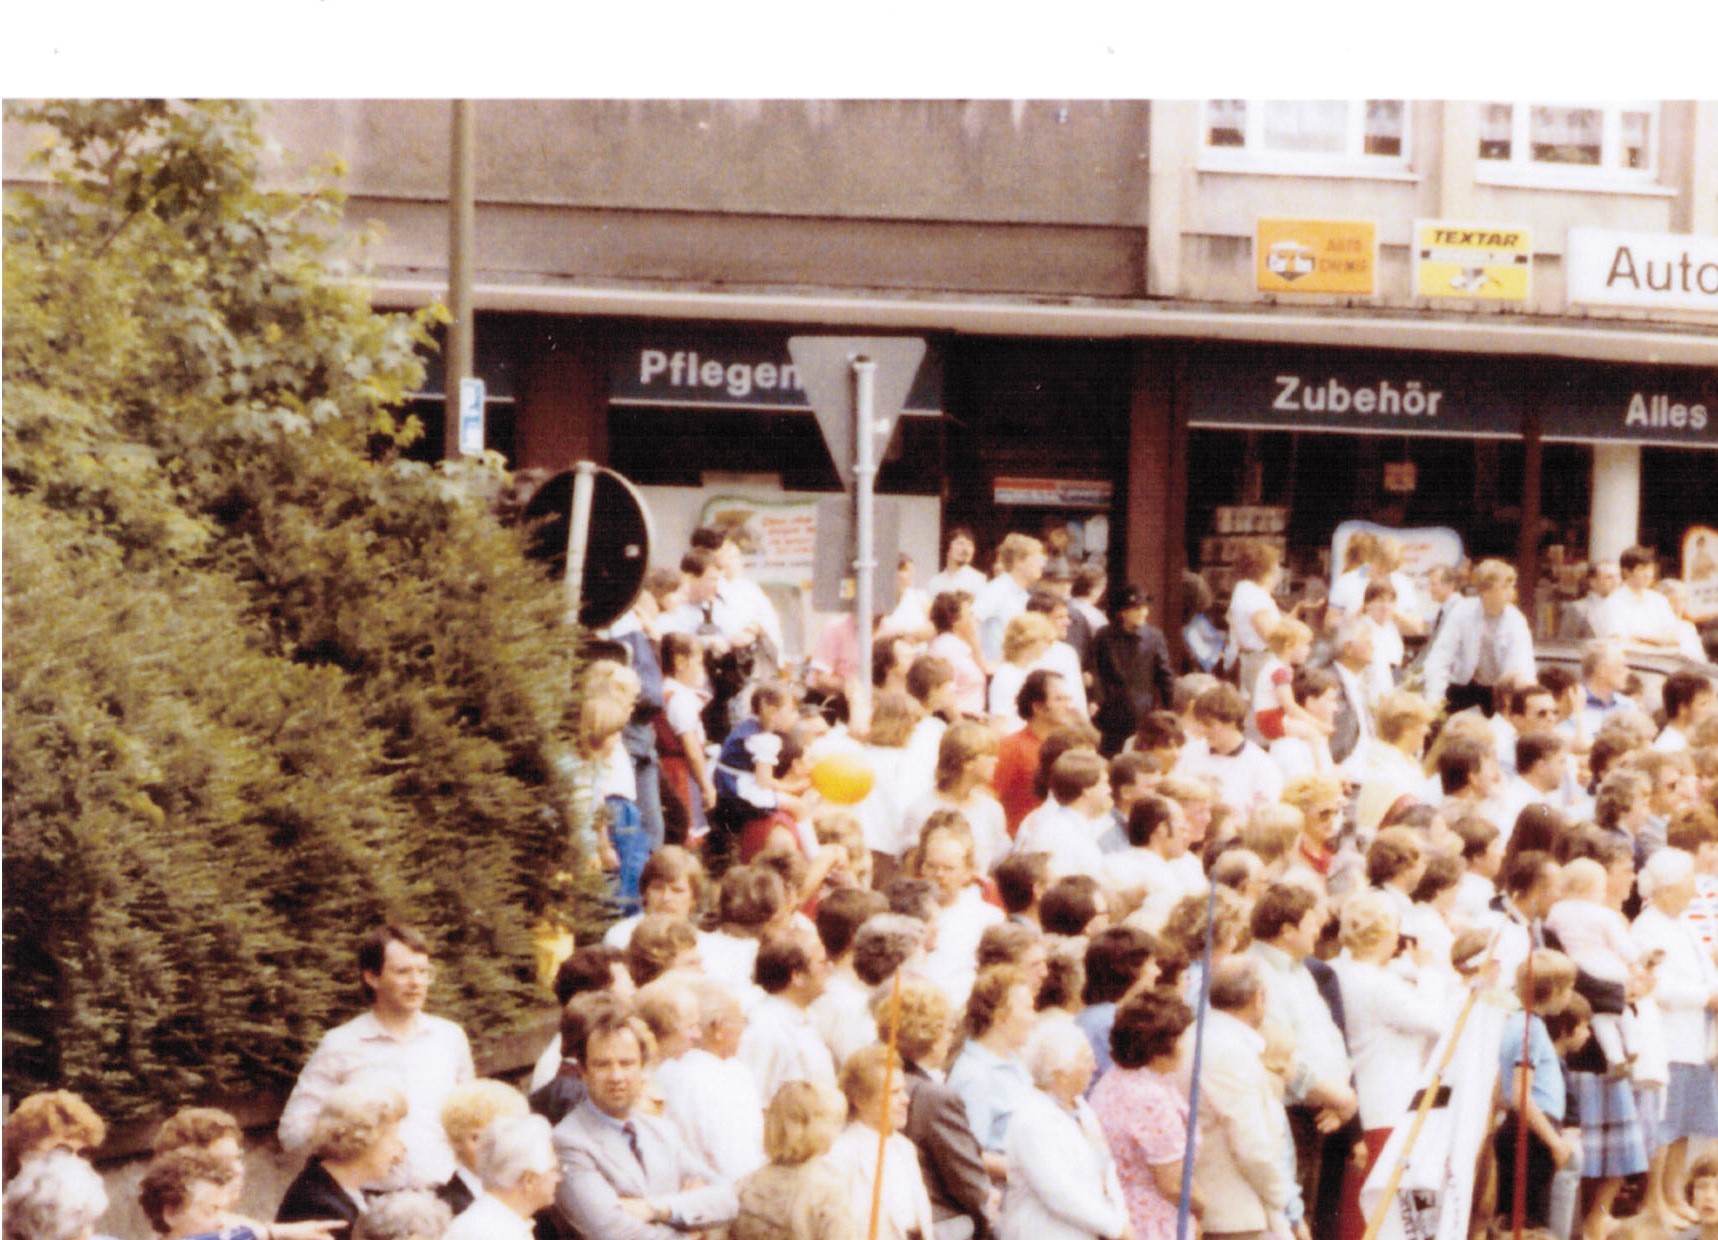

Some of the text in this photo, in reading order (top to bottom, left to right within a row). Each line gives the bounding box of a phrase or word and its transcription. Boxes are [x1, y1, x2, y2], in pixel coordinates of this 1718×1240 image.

[1432, 228, 1520, 248] TEXTAR
[1272, 375, 1443, 415] Zubehör
[1625, 392, 1708, 430] Alles
